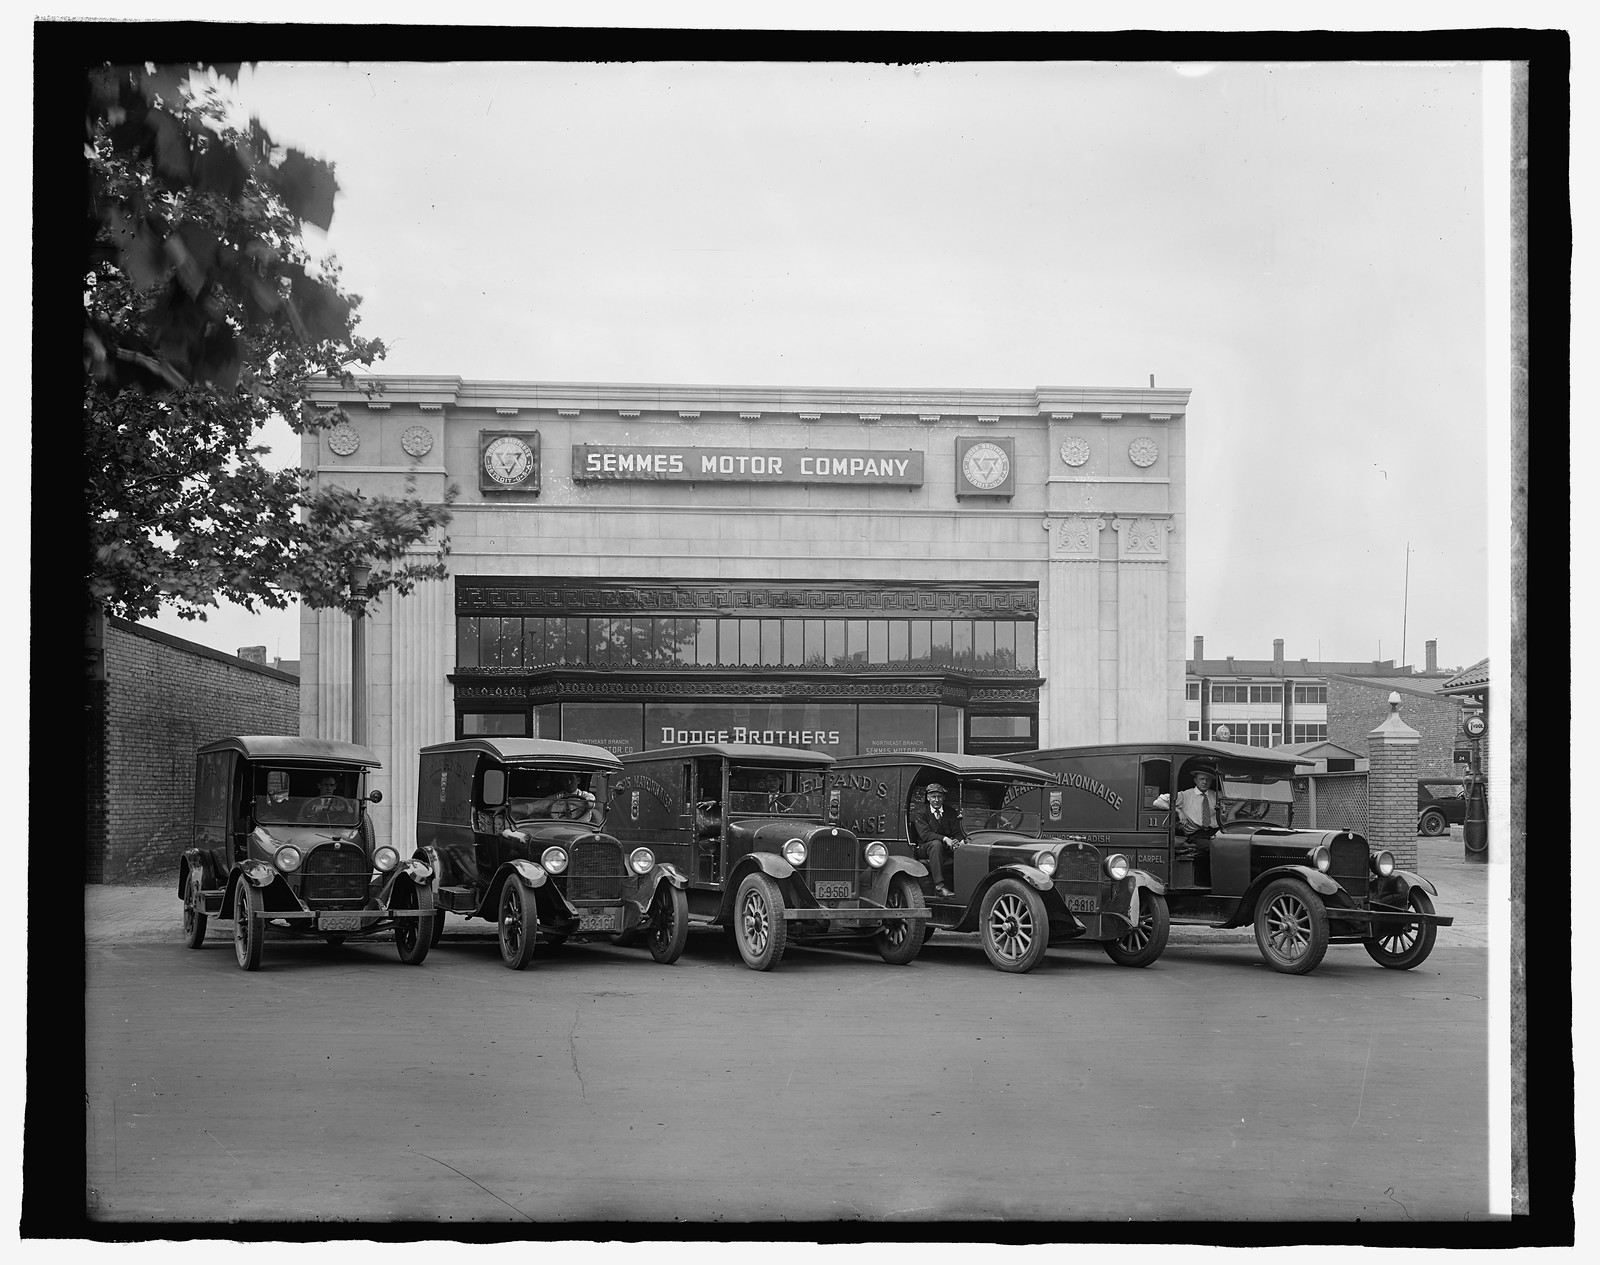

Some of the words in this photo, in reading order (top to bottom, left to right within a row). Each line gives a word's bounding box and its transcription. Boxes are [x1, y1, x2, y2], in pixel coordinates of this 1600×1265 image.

[586, 453, 684, 474] SEMMES
[701, 455, 783, 475] MOTOR
[800, 457, 909, 477] COMPANY
[661, 727, 730, 744] DODGE
[733, 727, 840, 744] BROTHERS
[1052, 772, 1124, 811] MAYONNAISE
[1148, 817, 1158, 828] 11
[1138, 854, 1165, 864] CARPEL,
[818, 886, 849, 898] C-9-560
[1068, 899, 1095, 912] C-9-818
